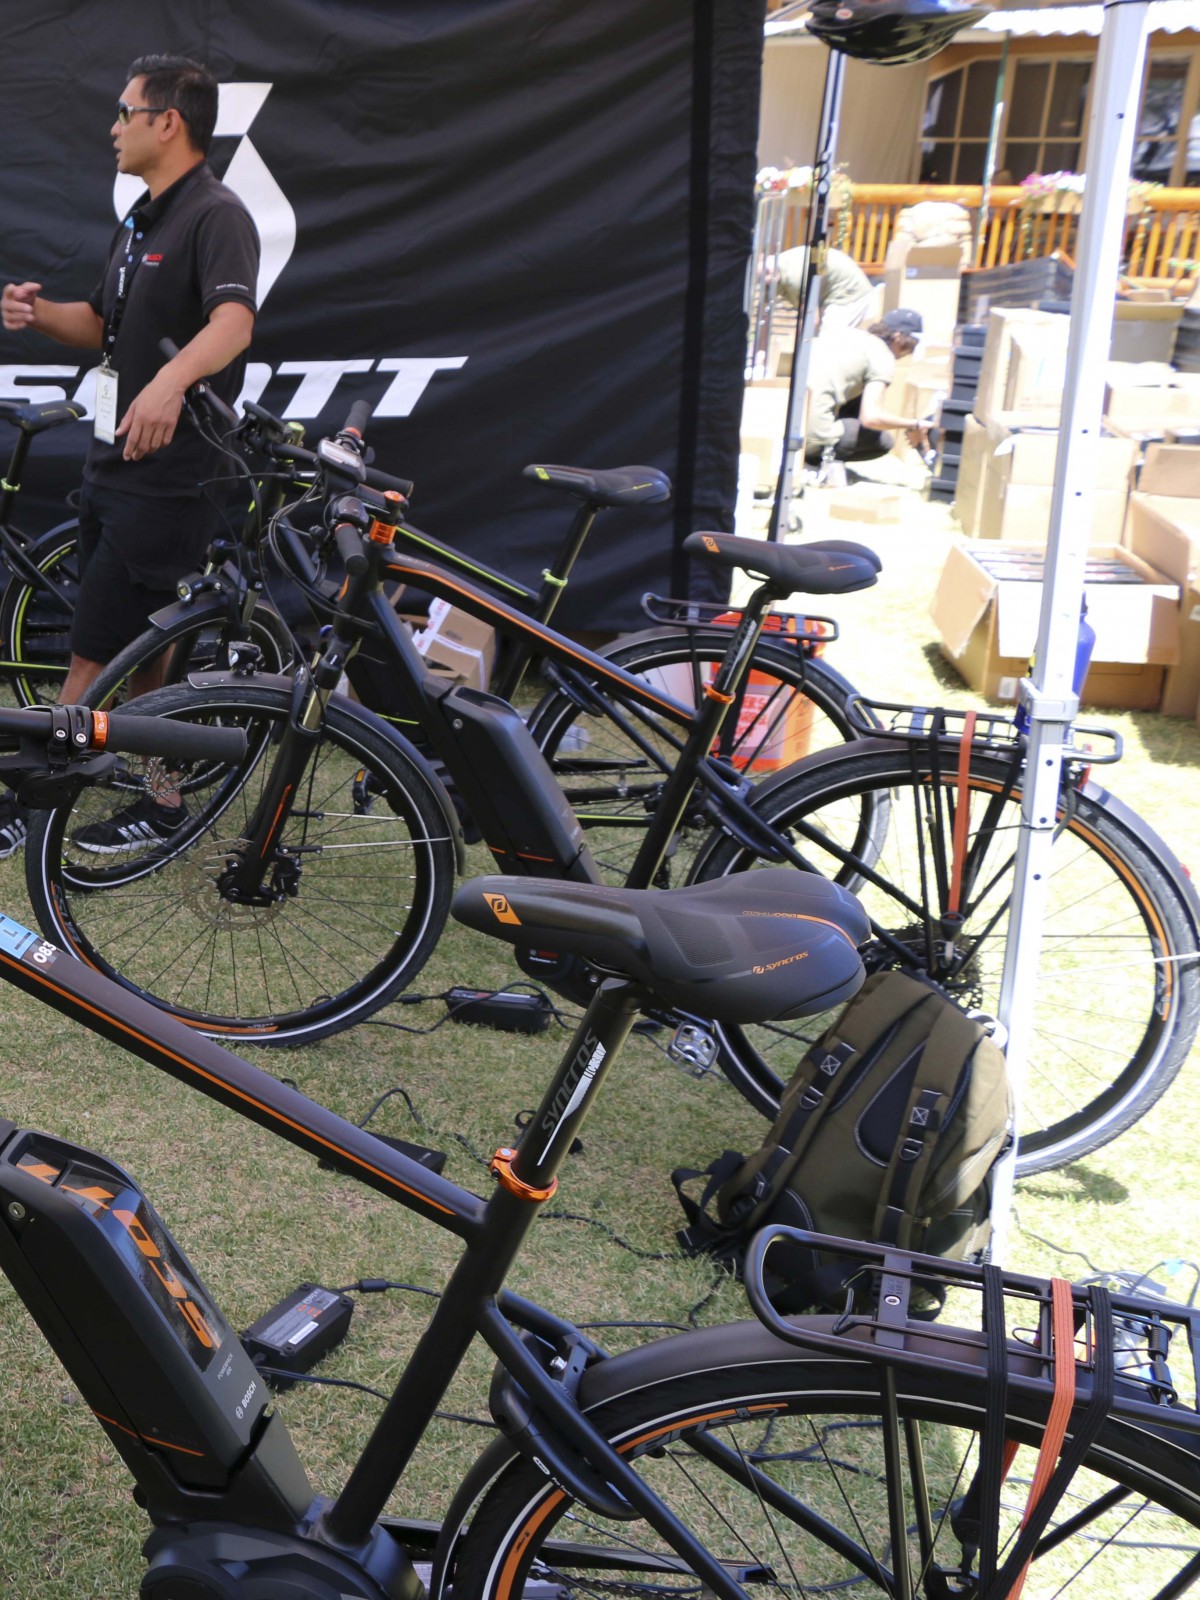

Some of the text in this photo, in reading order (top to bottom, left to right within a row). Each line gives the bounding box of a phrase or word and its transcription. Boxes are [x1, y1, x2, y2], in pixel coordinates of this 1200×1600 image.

[32, 940, 57, 964] 083
[766, 951, 809, 971] syncros
[217, 1352, 234, 1380] POWERPACK
[241, 1380, 257, 1409] BOSCH
